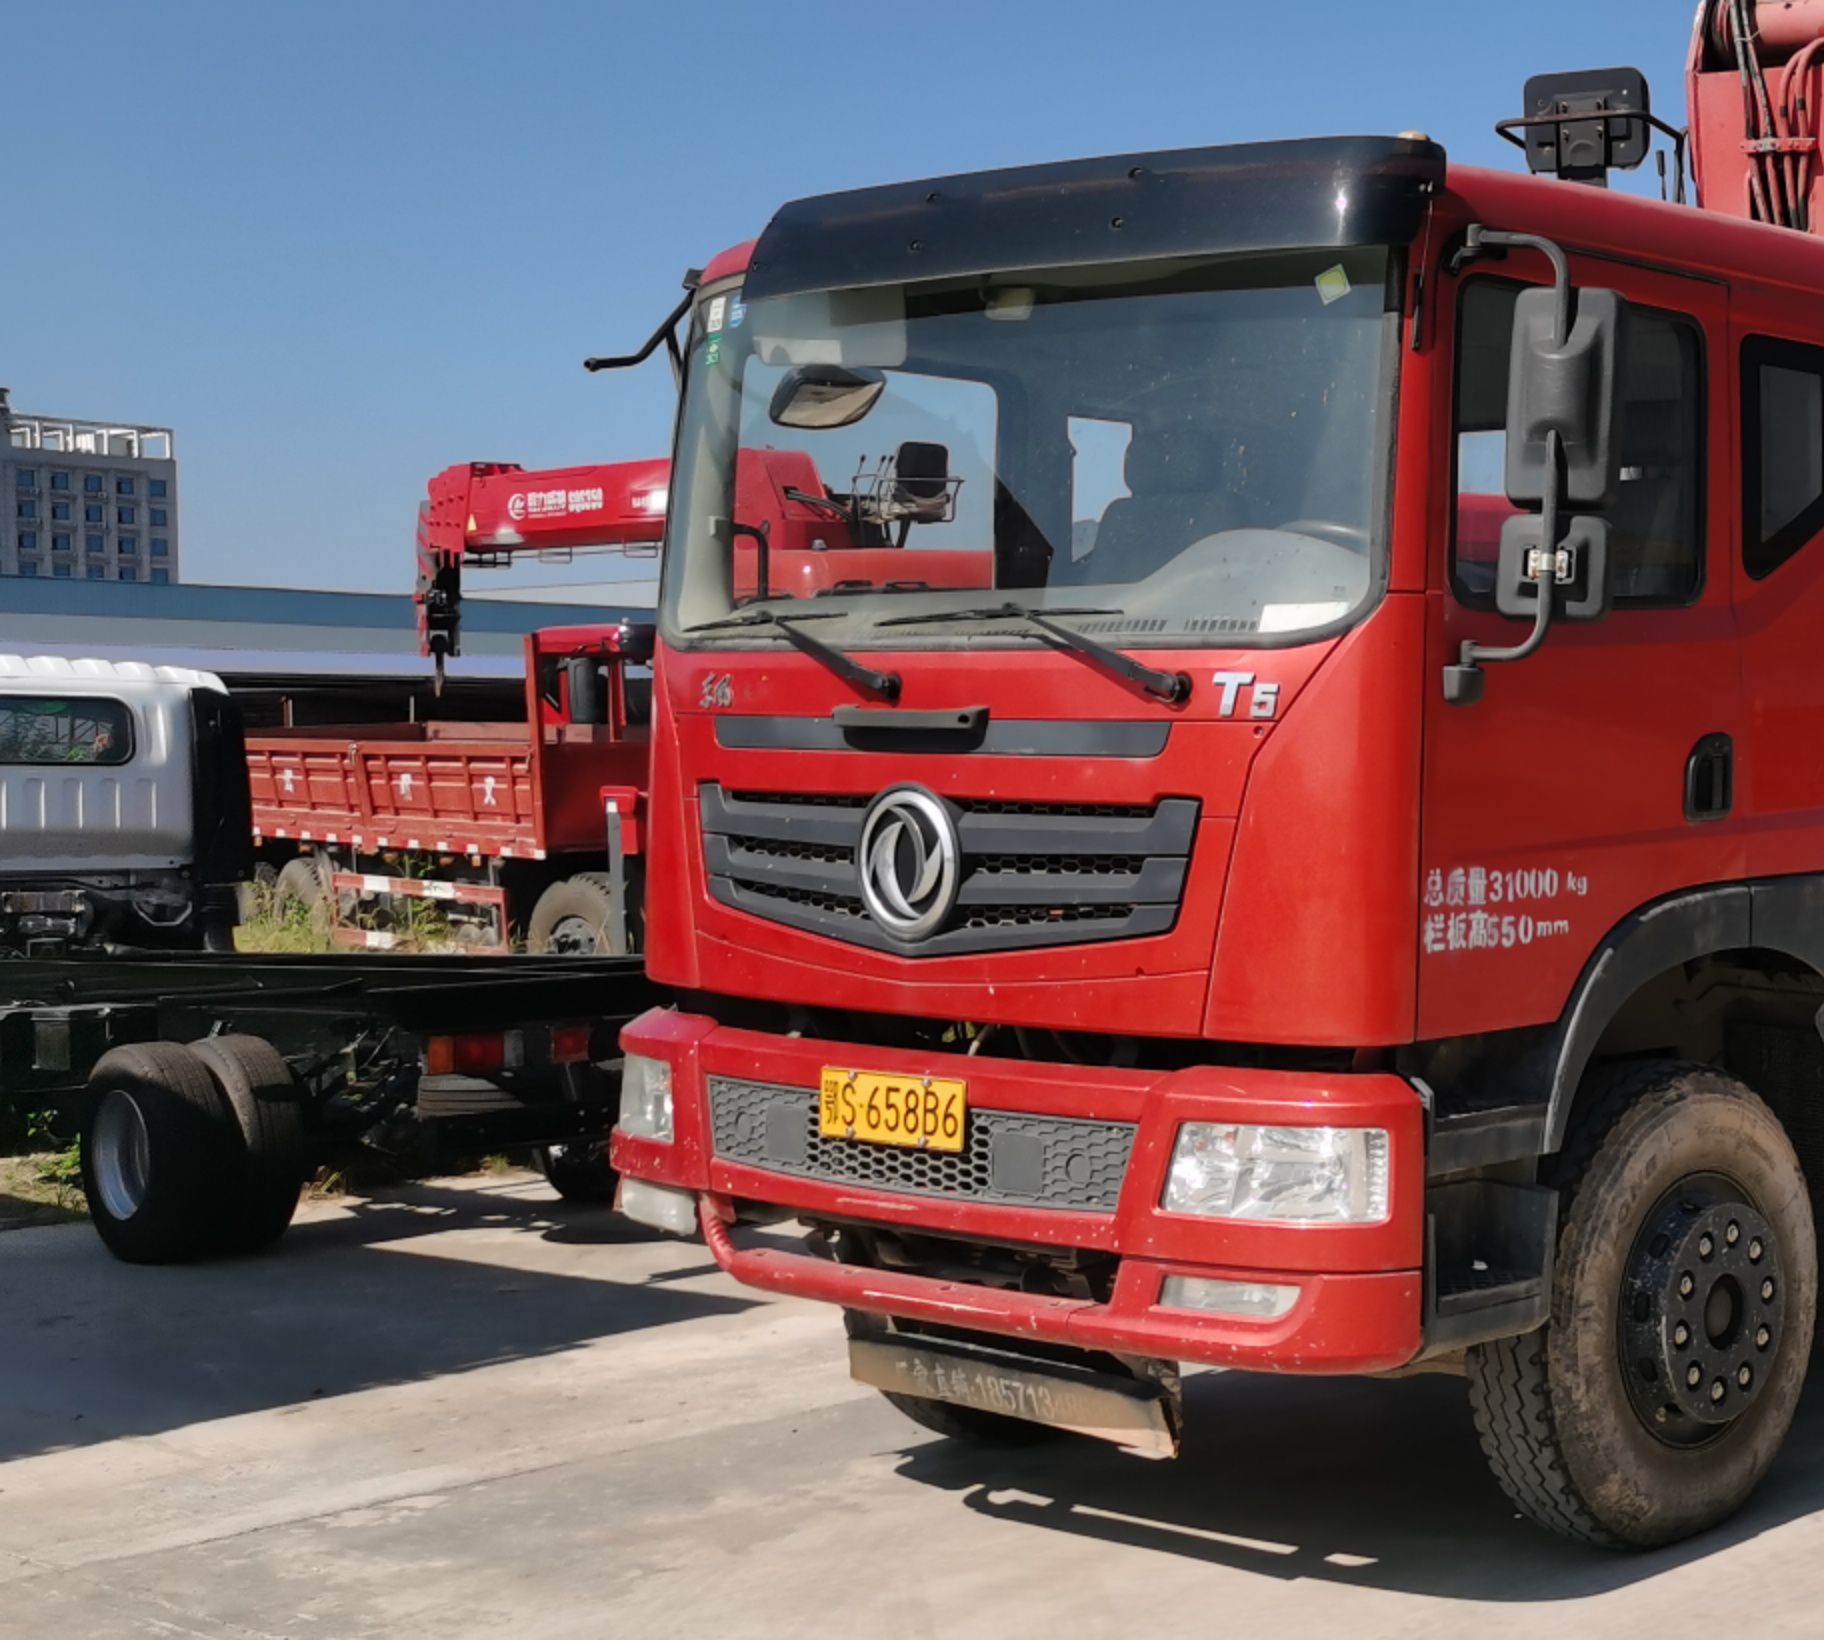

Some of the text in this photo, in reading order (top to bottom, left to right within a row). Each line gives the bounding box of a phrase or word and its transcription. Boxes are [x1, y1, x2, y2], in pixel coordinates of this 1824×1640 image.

[1212, 671, 1279, 718] T5
[1424, 866, 1588, 907] 总质量31000 kg
